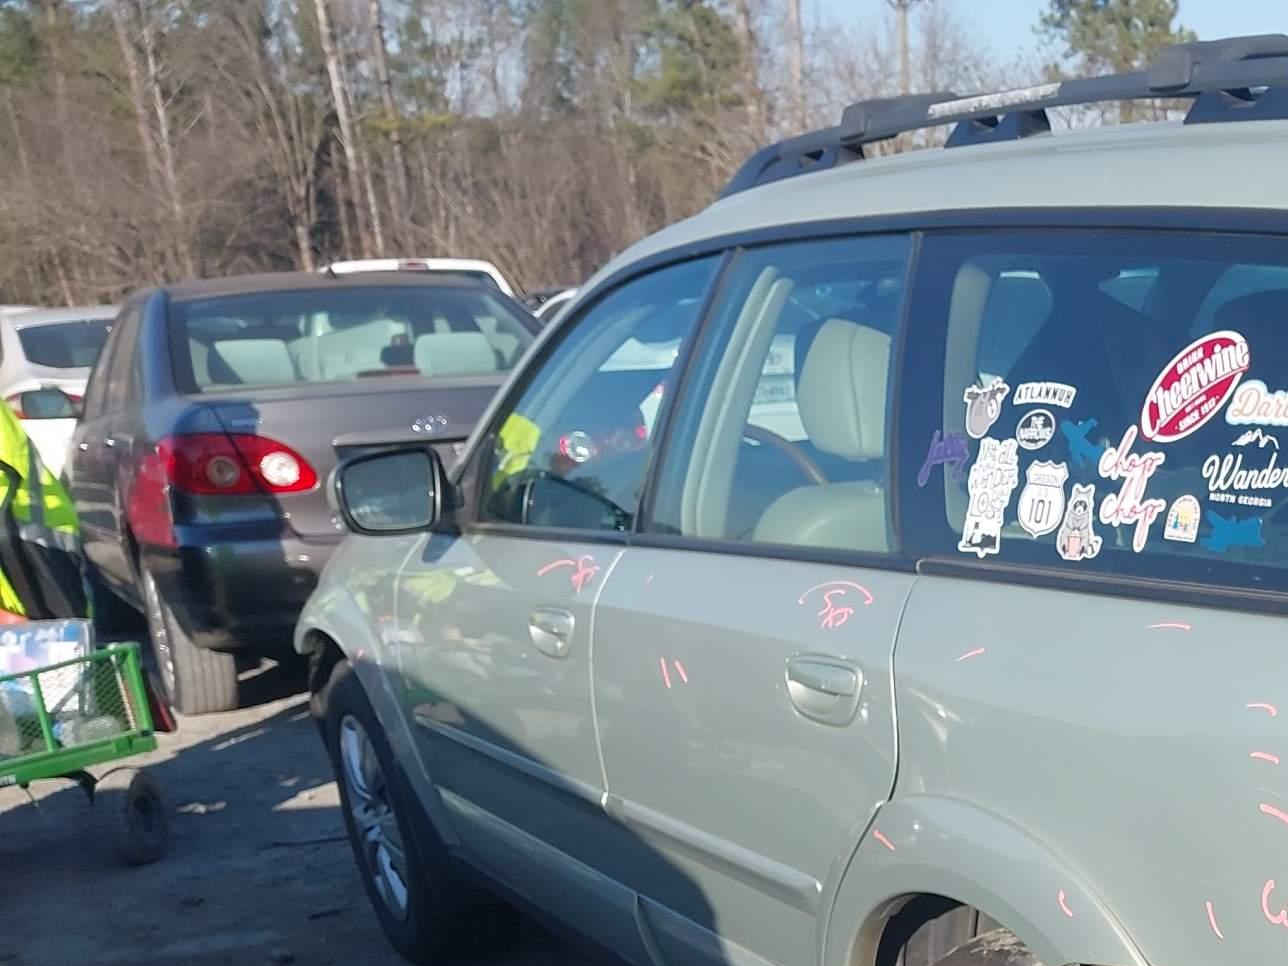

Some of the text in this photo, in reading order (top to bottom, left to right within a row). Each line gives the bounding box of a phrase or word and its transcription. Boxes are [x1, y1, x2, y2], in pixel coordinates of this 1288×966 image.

[1018, 386, 1073, 404] ATLANNUH
[1142, 341, 1250, 438] Cheerwine
[1101, 427, 1163, 498] chop
[1028, 498, 1052, 525] 101
[1101, 478, 1164, 550] chop
[1209, 492, 1272, 507] NORTH GEORGIA
